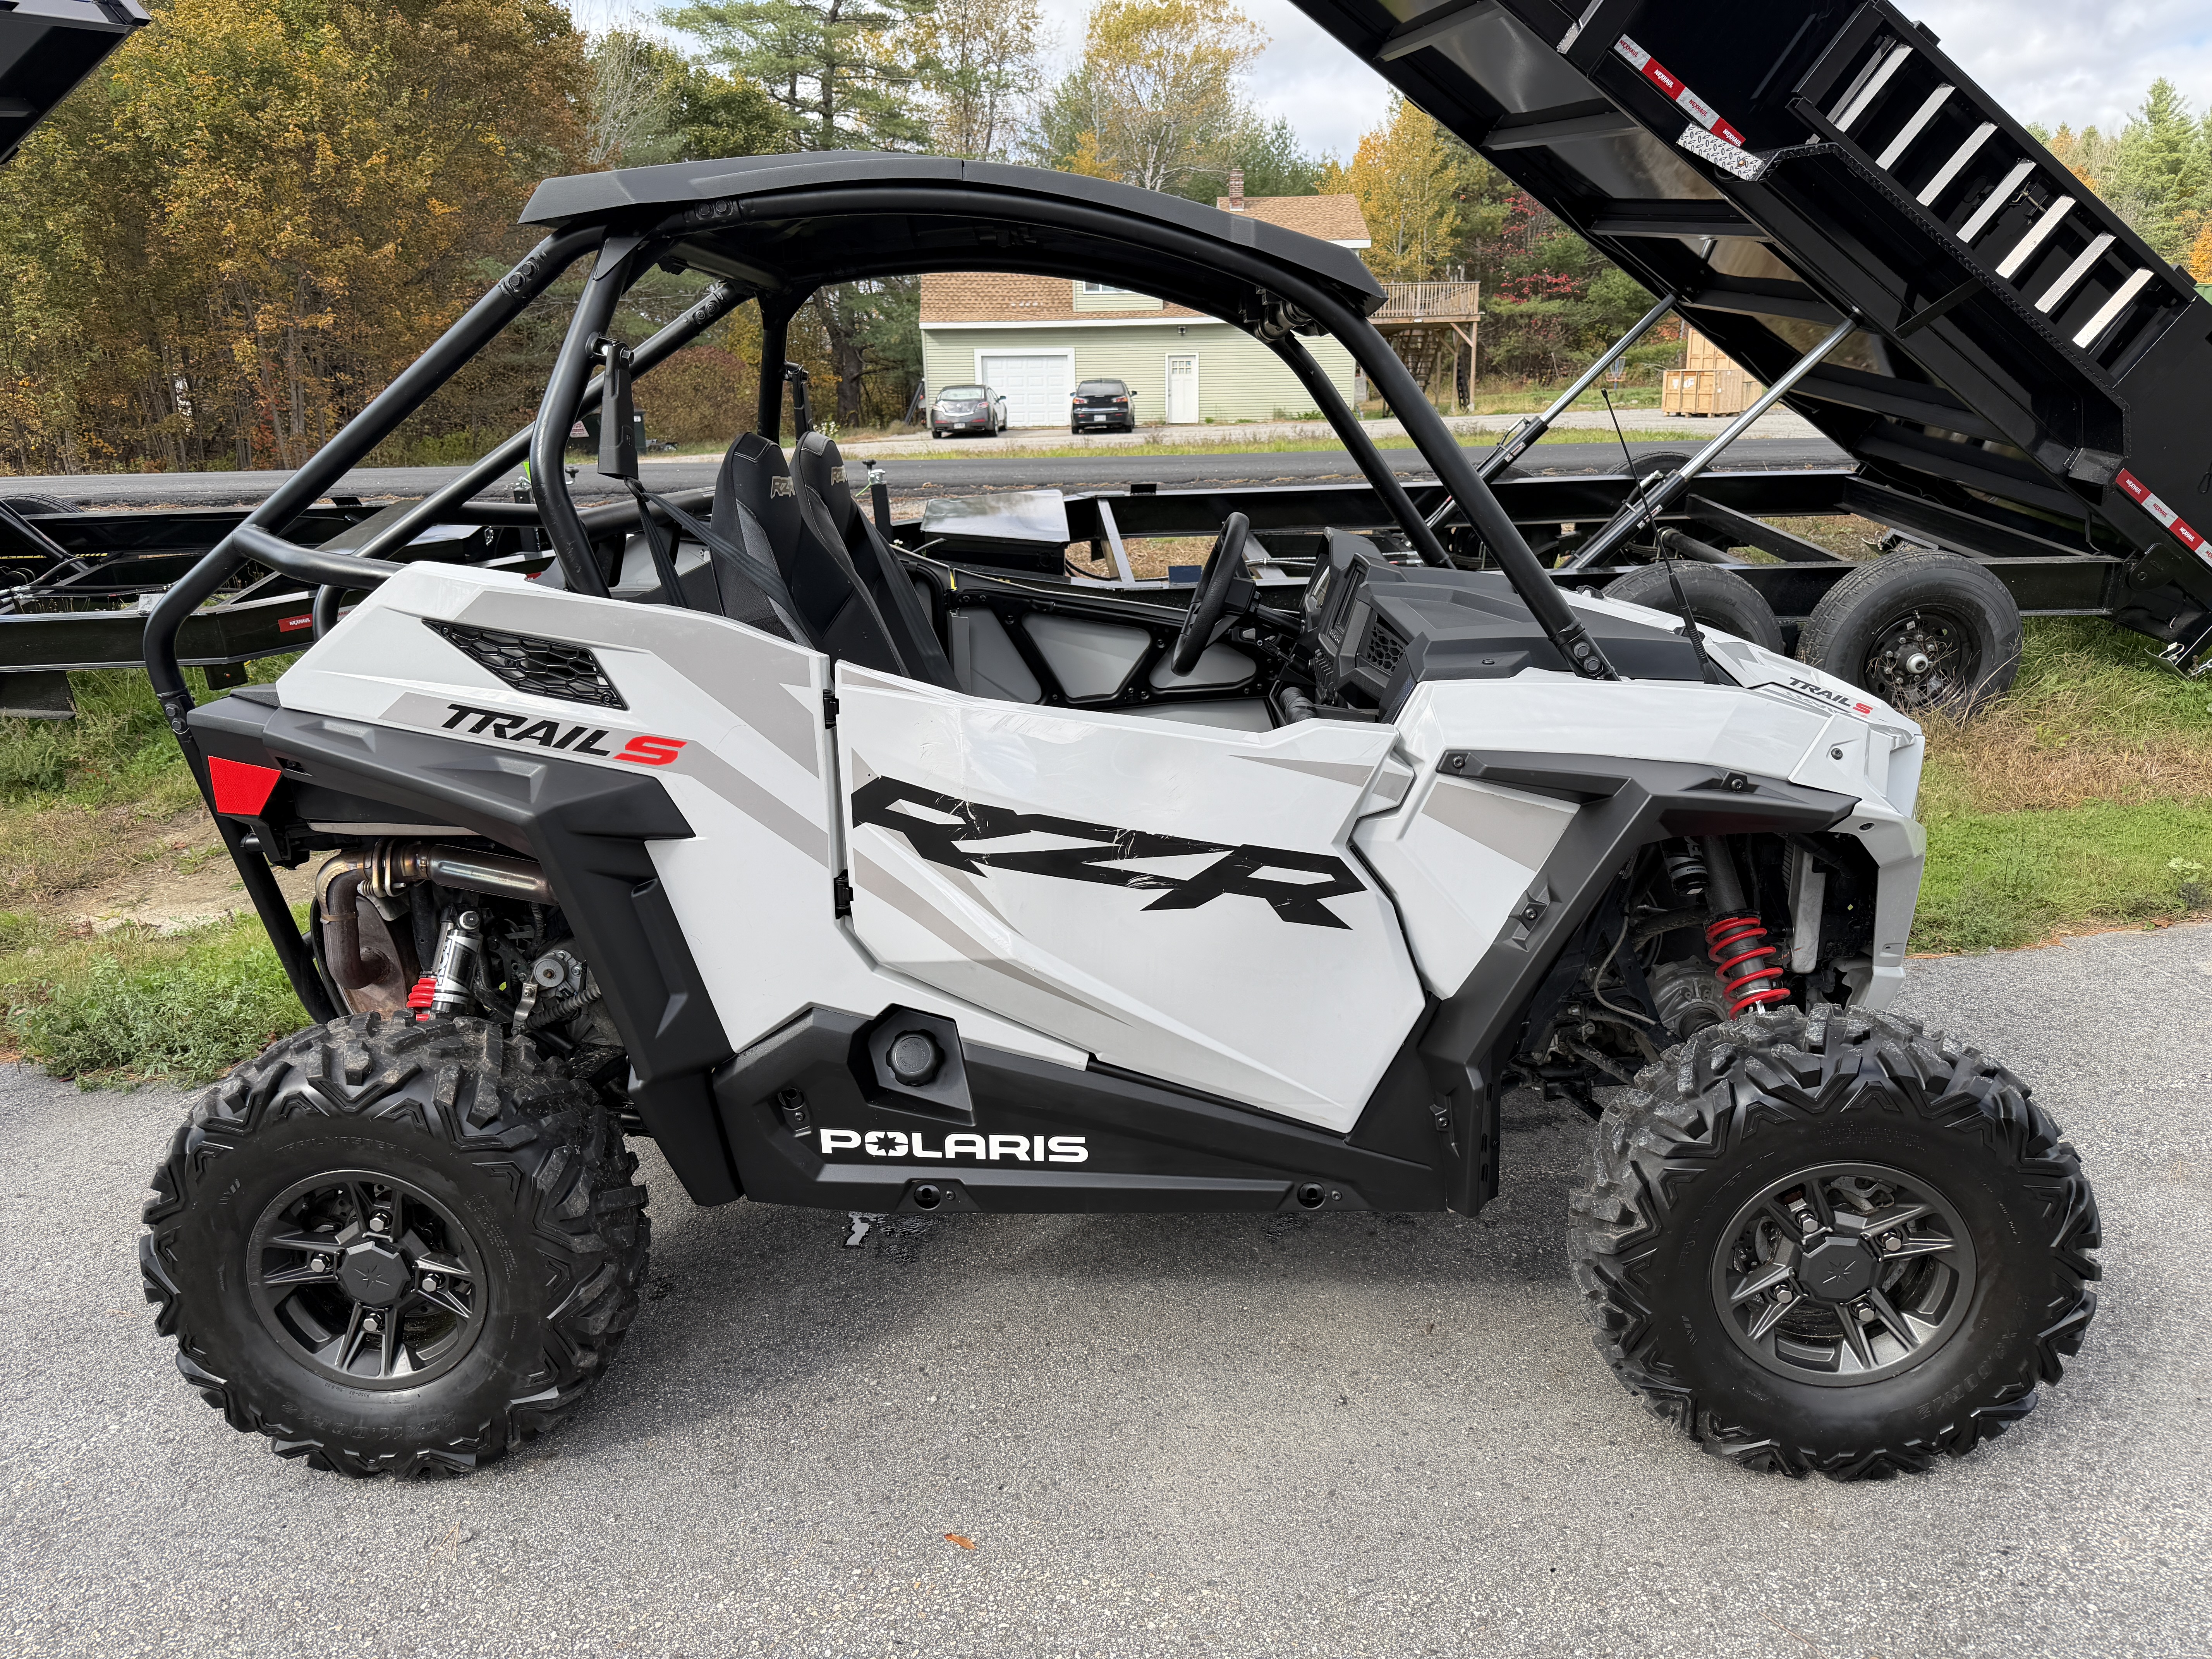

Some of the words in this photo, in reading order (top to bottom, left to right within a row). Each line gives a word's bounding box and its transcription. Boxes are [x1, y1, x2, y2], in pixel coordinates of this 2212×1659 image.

[1619, 40, 1638, 58] NEXHAUL
[1654, 69, 1674, 88] NEXHAUL
[1688, 99, 1707, 118] NEXHAUL
[1723, 128, 1742, 147] NEXHAUL
[2125, 479, 2142, 495] NEXHAUL
[2152, 503, 2168, 518] NEXHAUL
[2179, 527, 2195, 543] NEXHAUL
[1709, 592, 1738, 608] KENDA
[1789, 677, 1851, 707] TRAIL
[1852, 702, 1874, 714] S
[441, 703, 611, 756] TRAIL
[613, 735, 688, 766] S
[851, 775, 1368, 930] RZR
[819, 1128, 1089, 1163] POLARIS
[281, 1401, 457, 1440] 27X11.00R12
